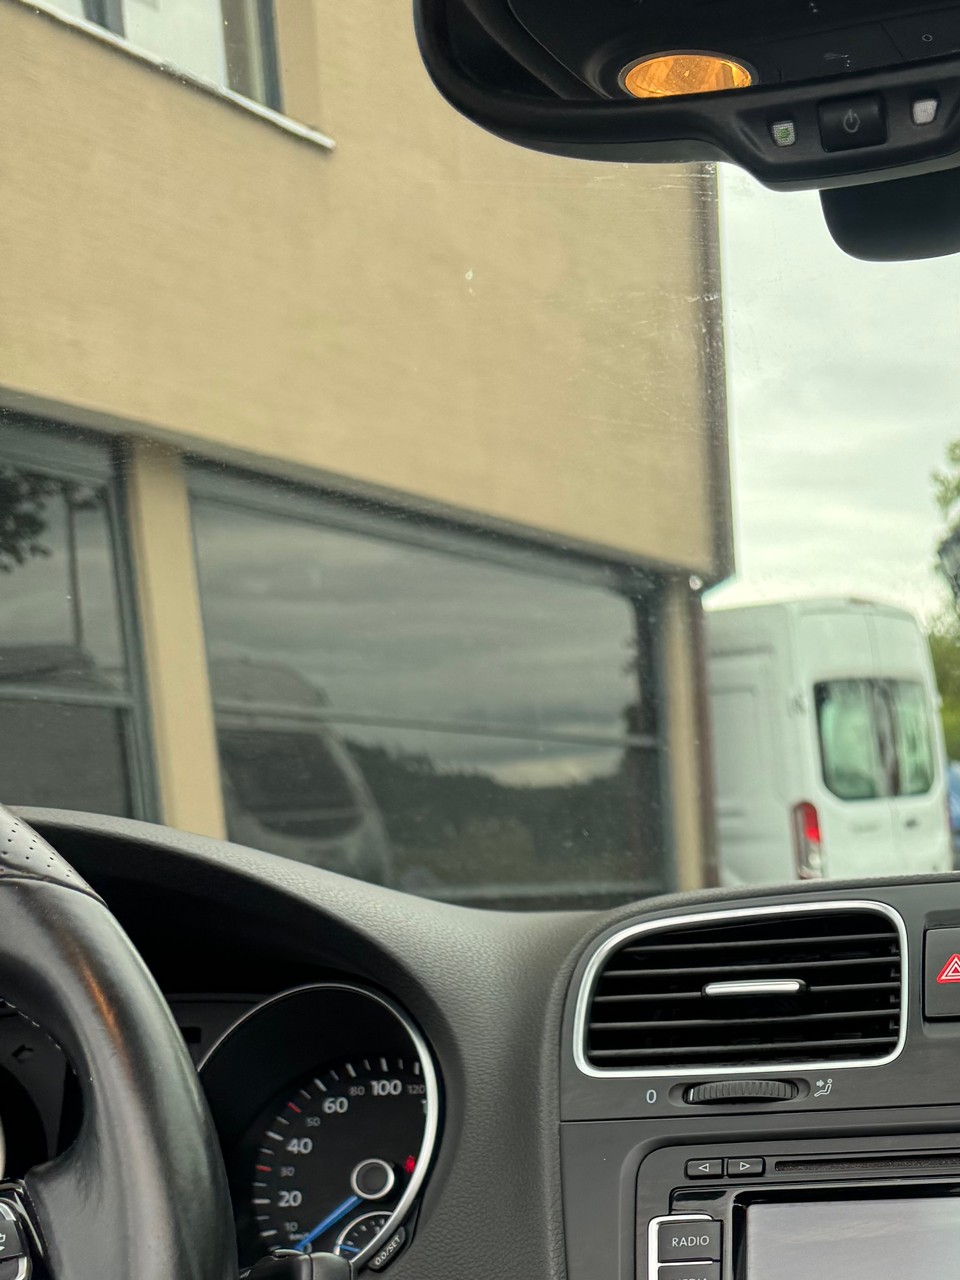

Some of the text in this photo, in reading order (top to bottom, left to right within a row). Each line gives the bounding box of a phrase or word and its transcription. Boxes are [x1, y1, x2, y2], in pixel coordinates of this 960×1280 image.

[350, 1085, 365, 1096] 80
[370, 1079, 402, 1096] 100
[407, 1085, 426, 1095] 120
[322, 1097, 348, 1114] 60
[286, 1137, 312, 1154] 40
[278, 1190, 302, 1207] 20
[286, 1222, 298, 1232] 10
[672, 1236, 710, 1247] RADIO
